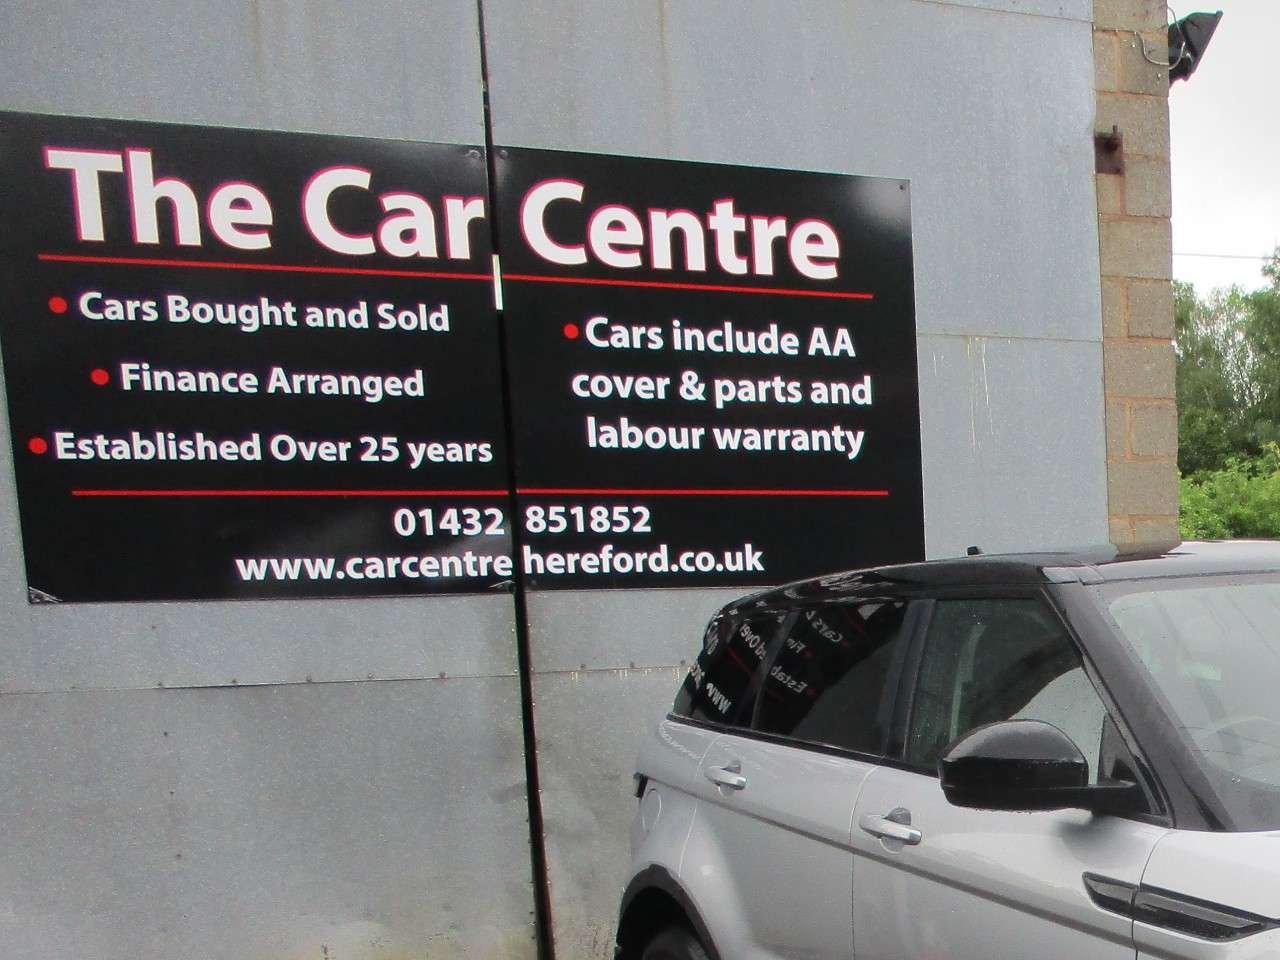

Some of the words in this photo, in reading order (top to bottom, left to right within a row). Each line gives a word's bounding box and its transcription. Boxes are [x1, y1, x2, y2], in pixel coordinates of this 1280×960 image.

[44, 147, 274, 250] The
[303, 165, 487, 260] Car
[521, 179, 840, 280] Centre
[79, 292, 159, 322] Cars
[167, 295, 298, 333] Bought
[305, 302, 369, 329] and
[377, 303, 450, 332] Sold
[585, 316, 663, 350] Cars
[672, 319, 799, 356] include
[807, 327, 857, 358] AA
[120, 362, 259, 394] Finance
[267, 366, 425, 402] Arranged
[571, 373, 671, 400] cover
[679, 370, 706, 401] &
[714, 375, 803, 409] parts
[810, 375, 873, 406] and
[54, 431, 262, 461] Established
[270, 434, 352, 462] Over
[359, 436, 400, 463] 25
[407, 442, 493, 470] years
[586, 416, 706, 450] labour
[712, 425, 865, 460] warranty
[393, 508, 505, 537] 01432
[525, 505, 652, 534] 851852
